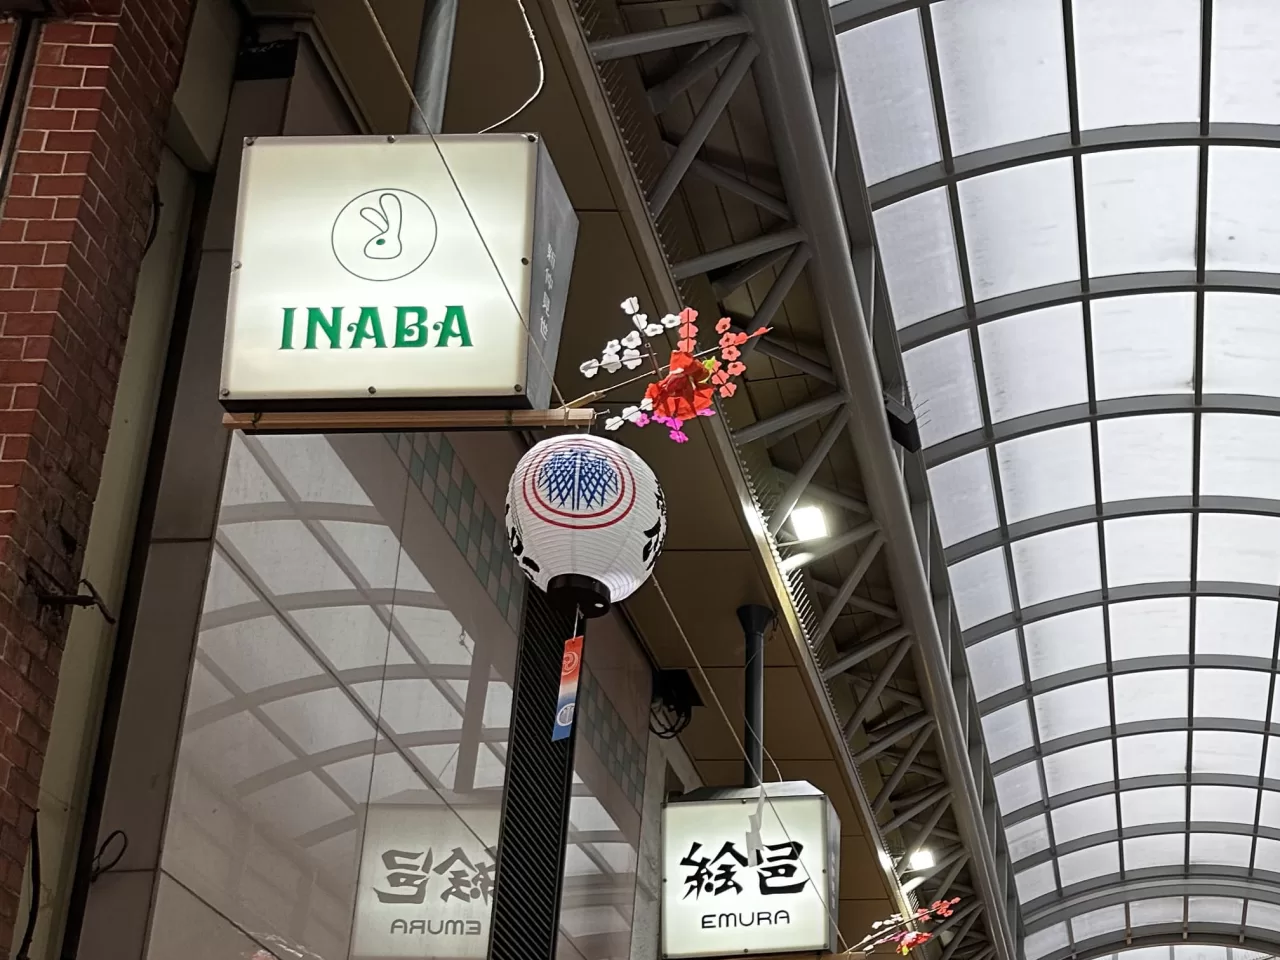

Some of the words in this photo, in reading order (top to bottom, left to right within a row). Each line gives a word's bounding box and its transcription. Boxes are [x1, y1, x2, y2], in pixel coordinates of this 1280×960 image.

[279, 306, 473, 350] INABA
[680, 841, 810, 900] 絵邑
[701, 910, 791, 929] EMURA
